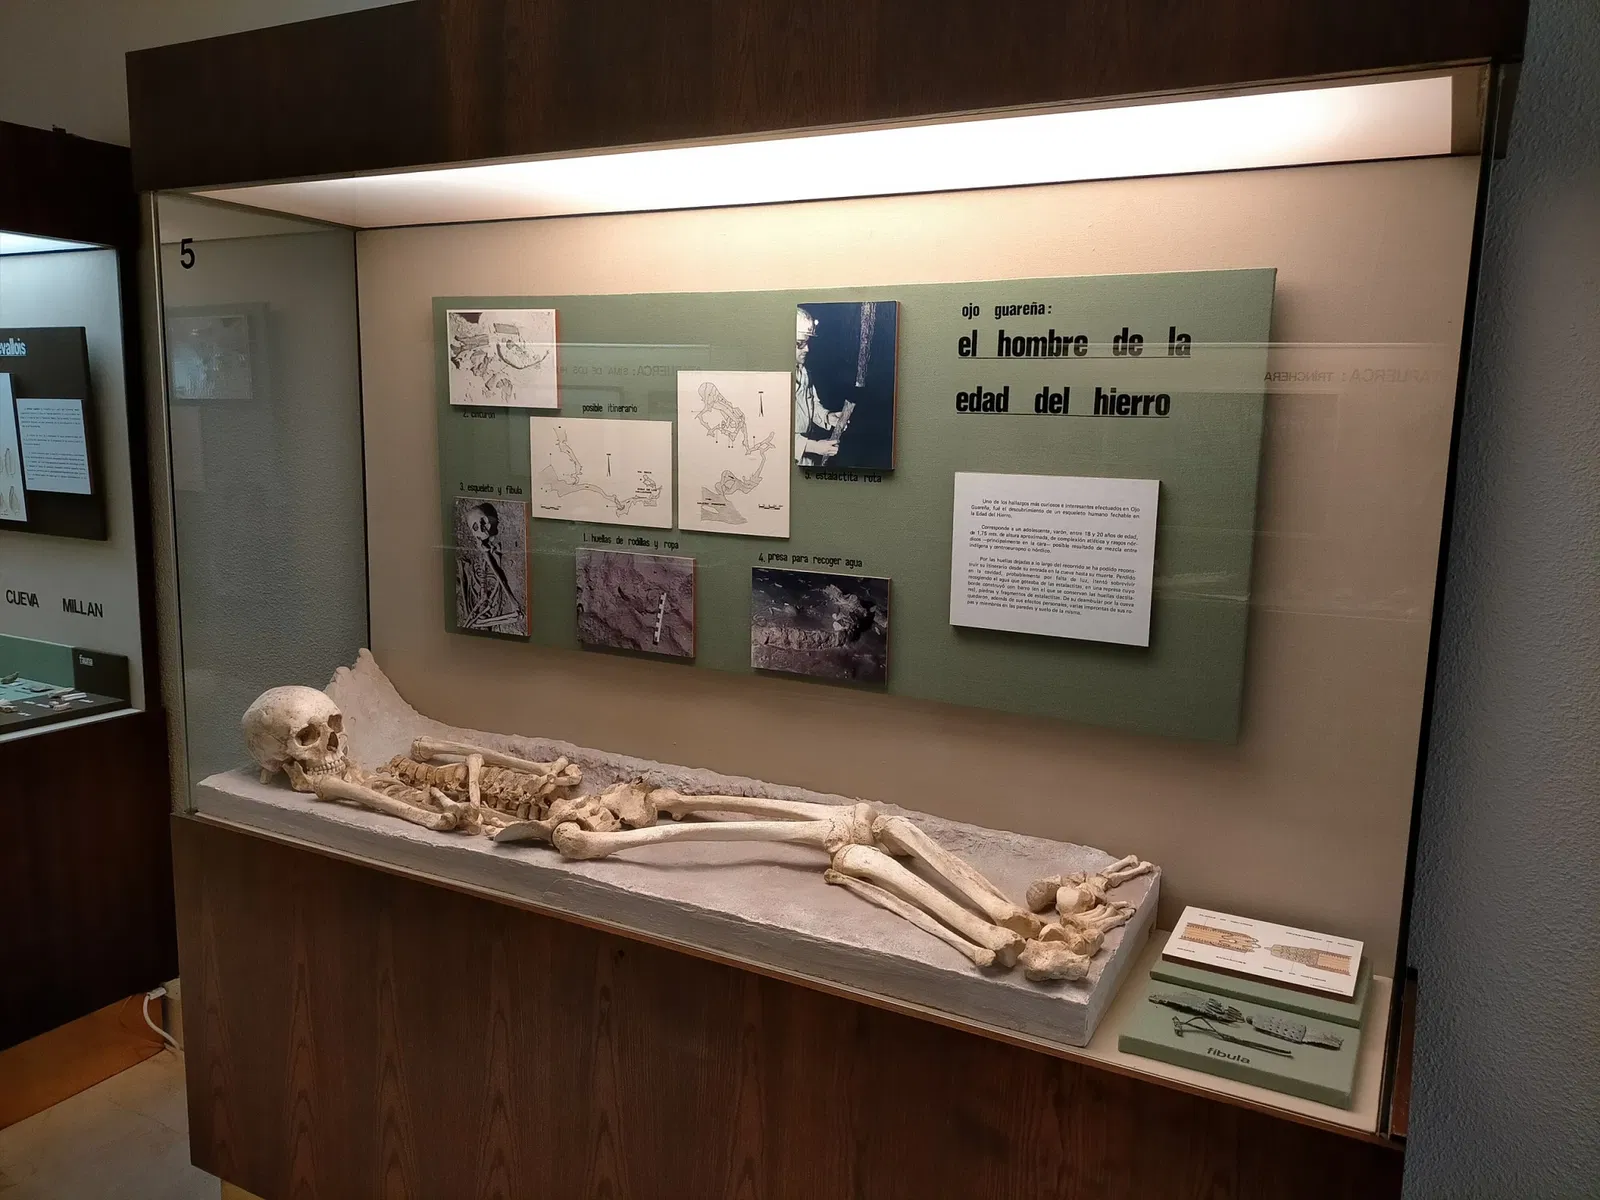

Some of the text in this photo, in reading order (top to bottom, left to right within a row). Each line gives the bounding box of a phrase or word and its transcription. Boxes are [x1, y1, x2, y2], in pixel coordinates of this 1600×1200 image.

[180, 238, 195, 269] 5
[962, 301, 1052, 320] ojo guareña:
[958, 326, 1192, 357] el hombre de la
[582, 403, 638, 414] posible itinerario
[956, 386, 1171, 416] edad del hierro
[815, 471, 858, 482] estalactita
[864, 473, 882, 483] rota
[468, 483, 494, 494] esqueleto
[497, 487, 502, 495] y
[1023, 527, 1051, 535] adolescente,
[591, 533, 611, 543] huellas
[616, 535, 623, 544] de
[628, 537, 650, 546] rodillas
[654, 540, 658, 550] y
[663, 541, 679, 551] ropa
[758, 553, 863, 569] 4. presa para recoger agua
[1001, 589, 1025, 597] fragmentos
[6, 589, 104, 618] CUEVA MILLAN
